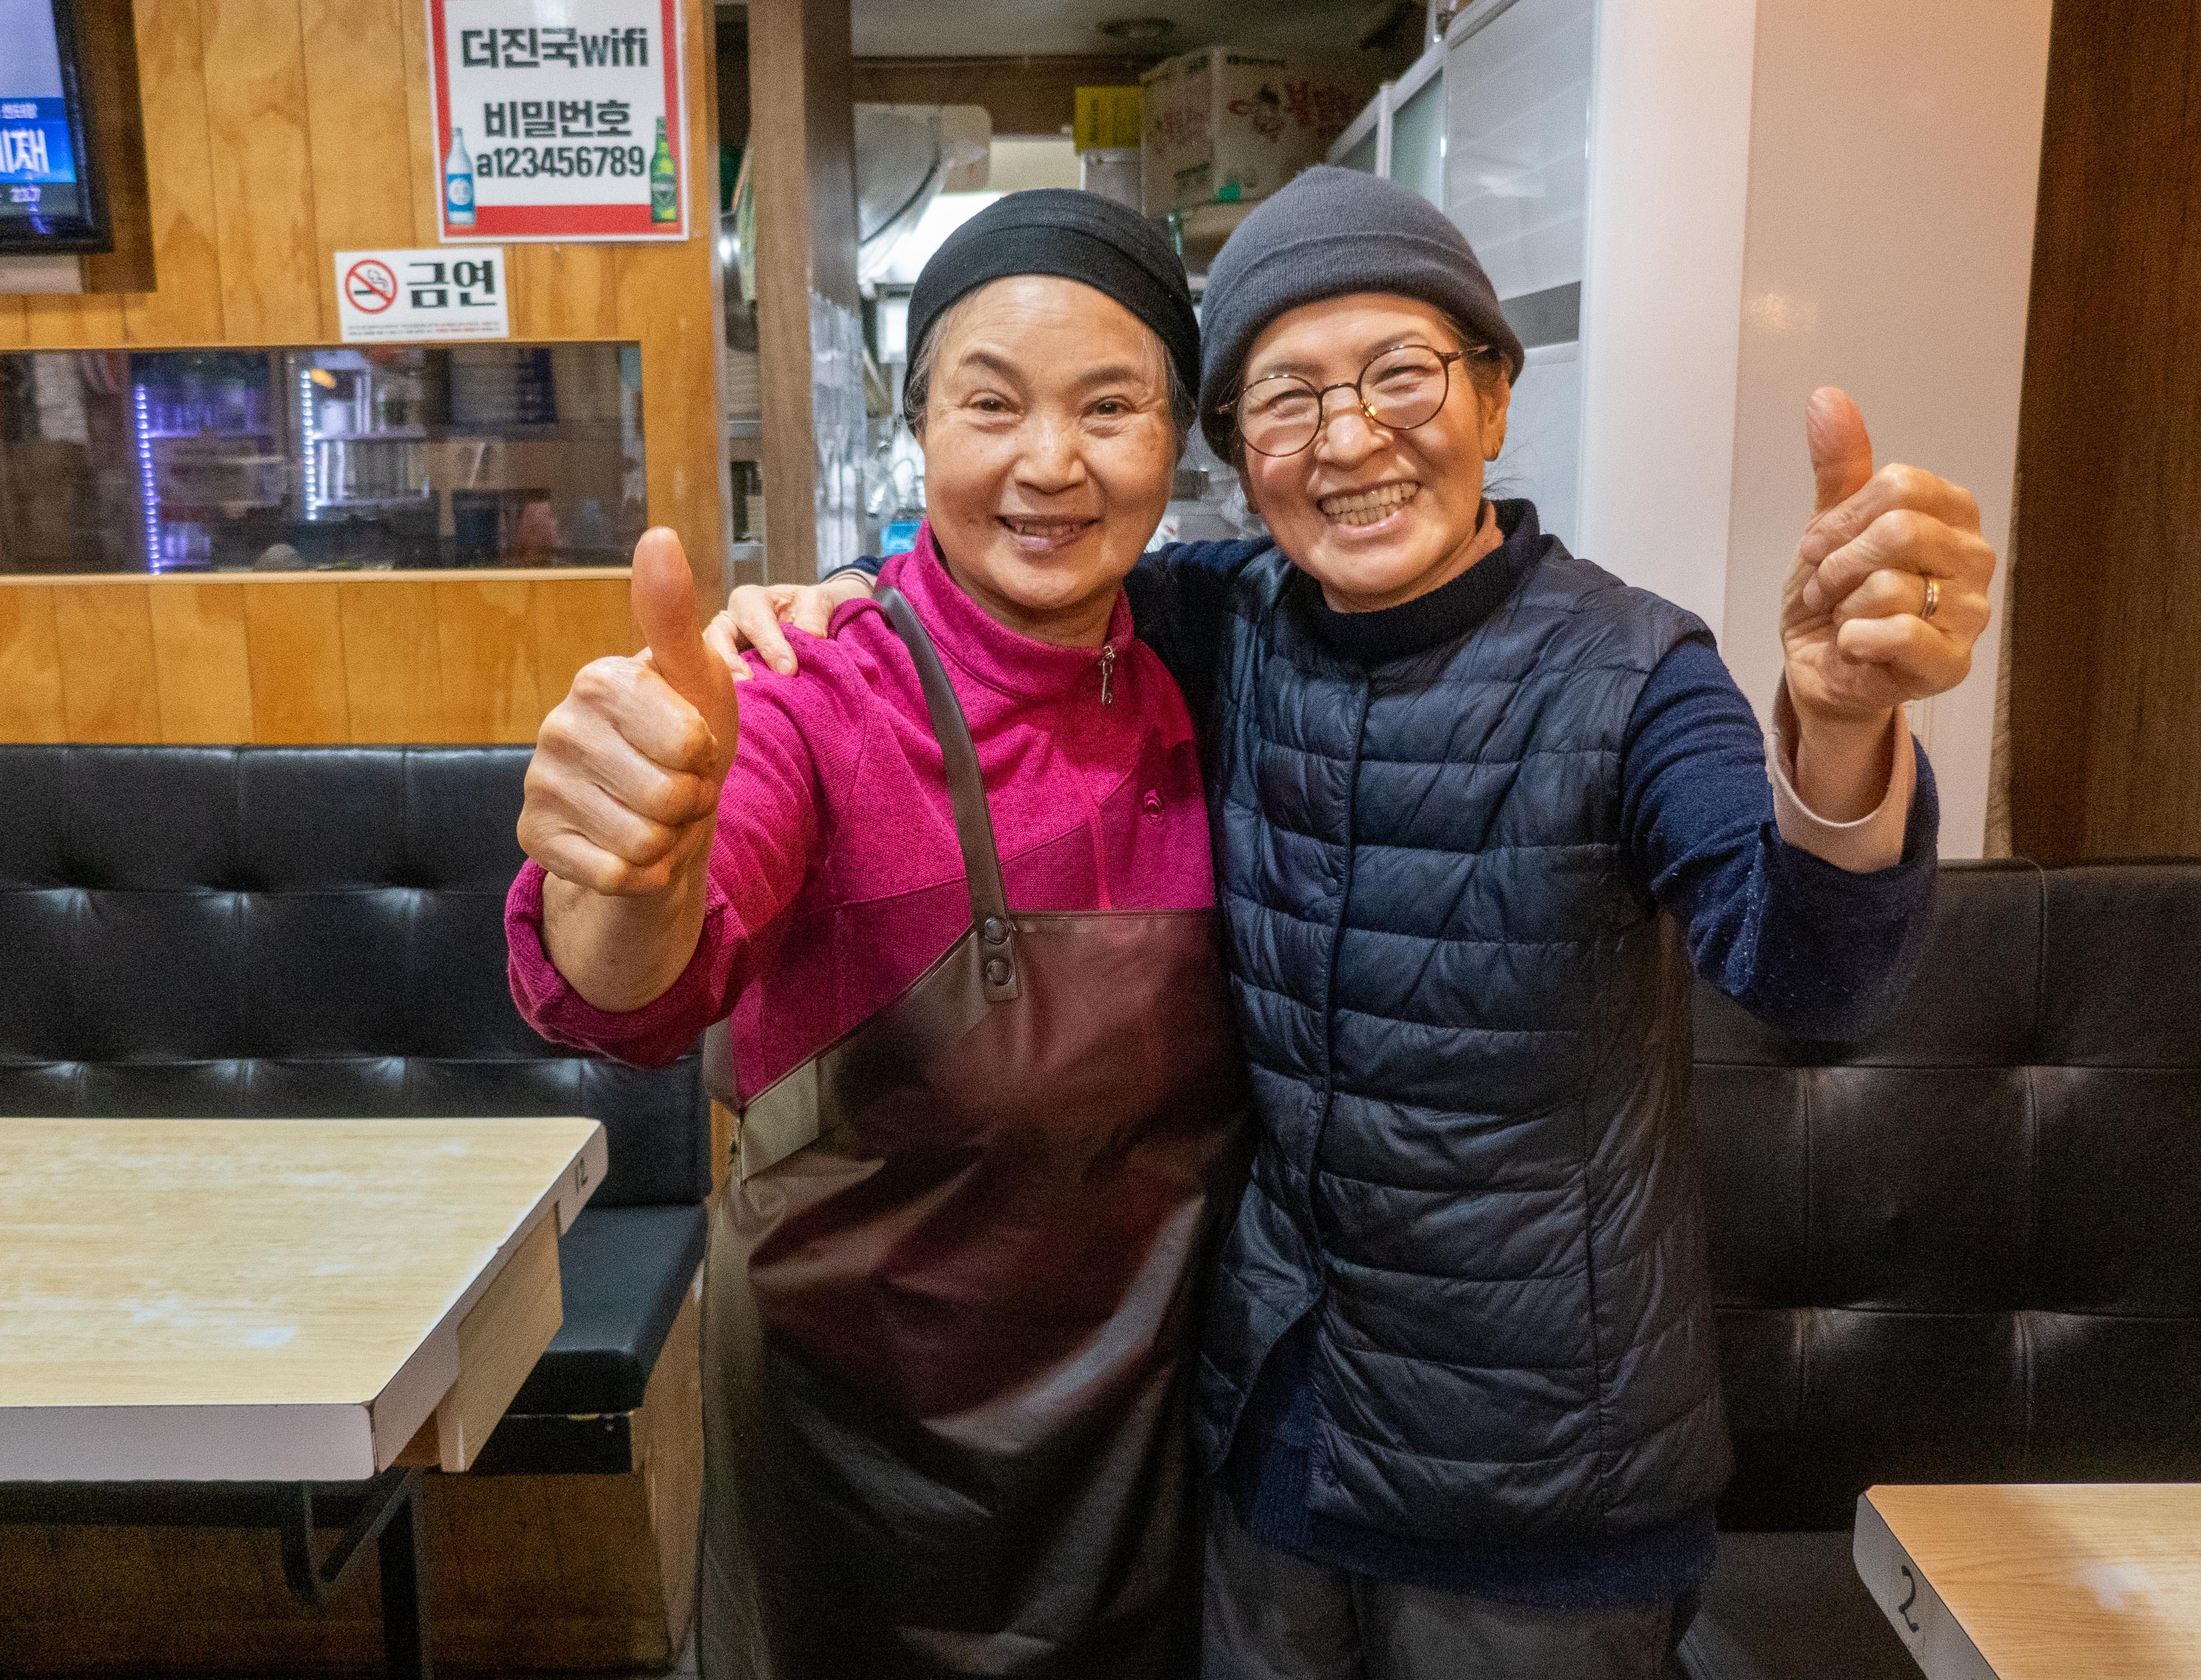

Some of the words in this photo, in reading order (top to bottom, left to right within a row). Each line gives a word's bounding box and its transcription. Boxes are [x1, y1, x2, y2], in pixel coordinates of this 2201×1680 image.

[461, 27, 648, 68] 더진국wifi
[484, 99, 631, 138] 비밀번호
[476, 146, 645, 178] a123456789
[407, 260, 497, 309] 금연
[1898, 1565, 1919, 1633] 2
